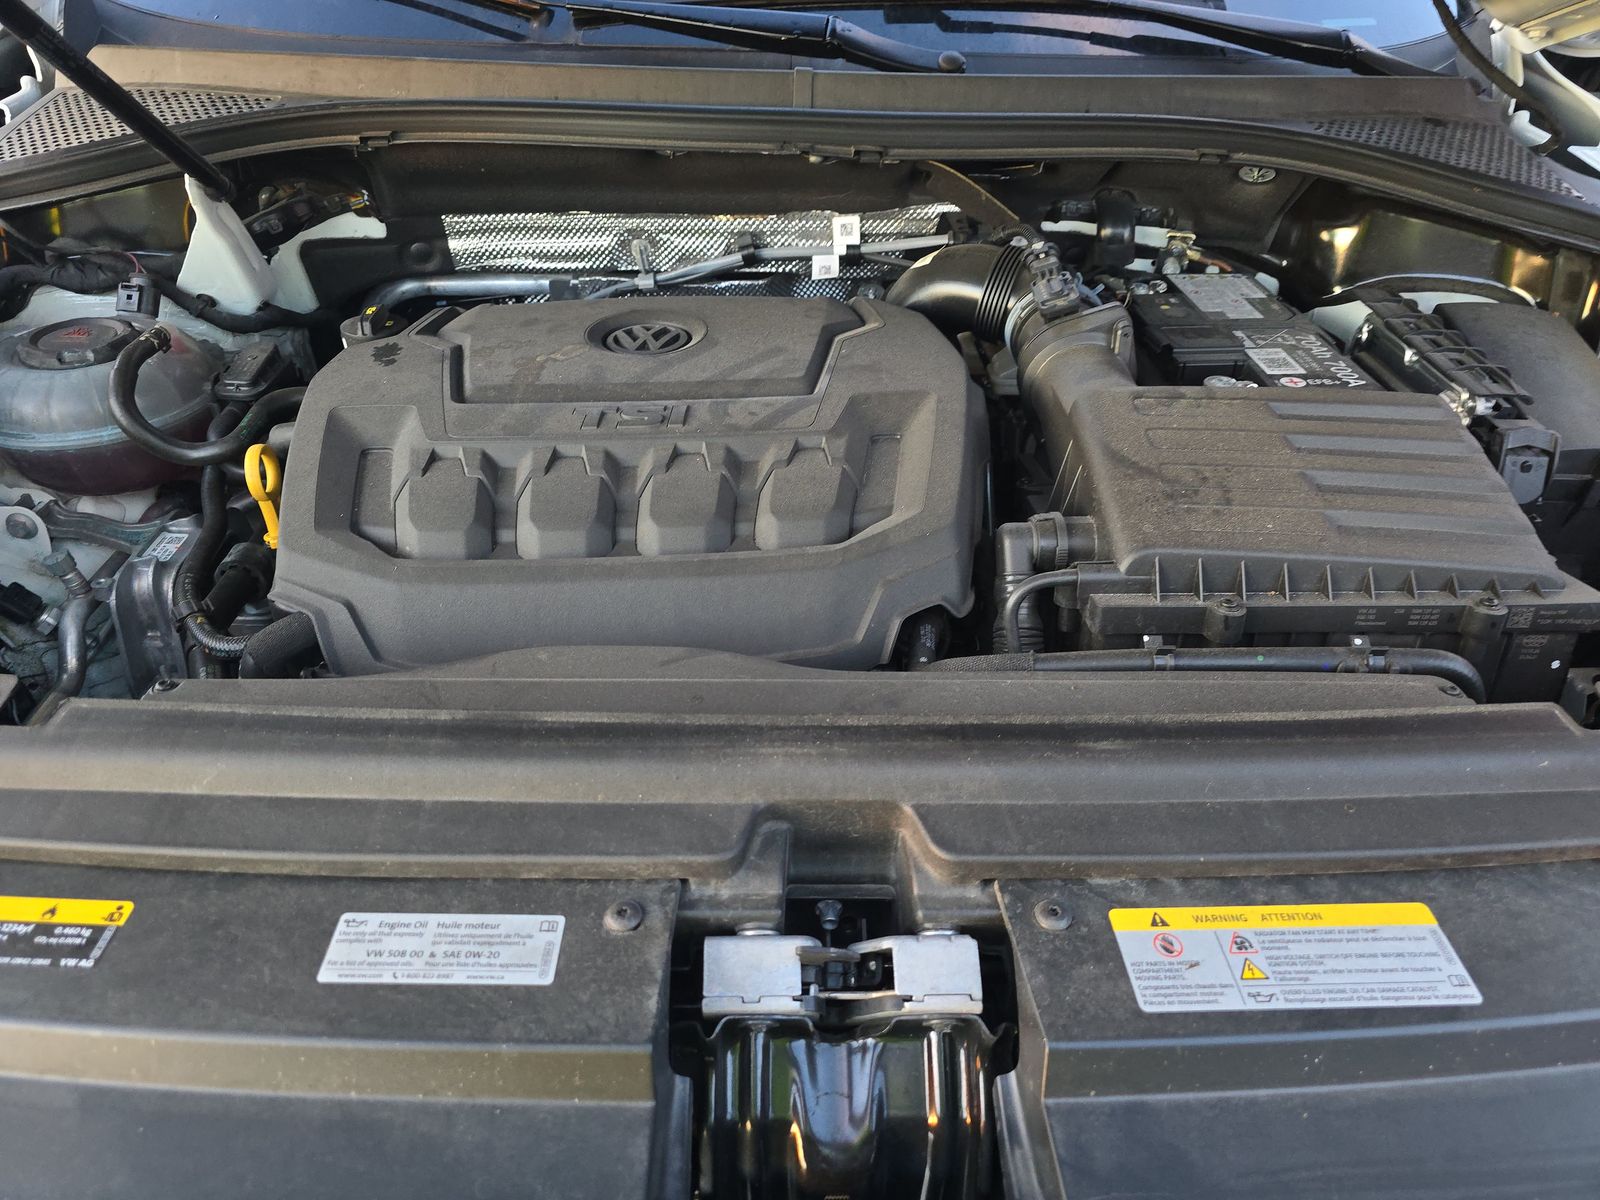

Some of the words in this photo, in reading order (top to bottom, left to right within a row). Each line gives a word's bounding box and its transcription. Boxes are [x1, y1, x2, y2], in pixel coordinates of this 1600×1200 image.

[1295, 334, 1334, 358] 70Ah
[1324, 360, 1366, 387] 700A
[572, 404, 690, 430] TSI
[1192, 913, 1248, 923] WARNING
[1260, 912, 1323, 922] ATTENTION
[378, 920, 411, 930] Engine
[414, 921, 428, 929] Oil
[437, 921, 462, 929] Huile
[465, 922, 502, 930] moteur
[366, 949, 386, 958] VW
[387, 950, 407, 958] 508
[409, 950, 424, 958] 00
[442, 950, 462, 959] SAE
[465, 951, 500, 959] 0W-20
